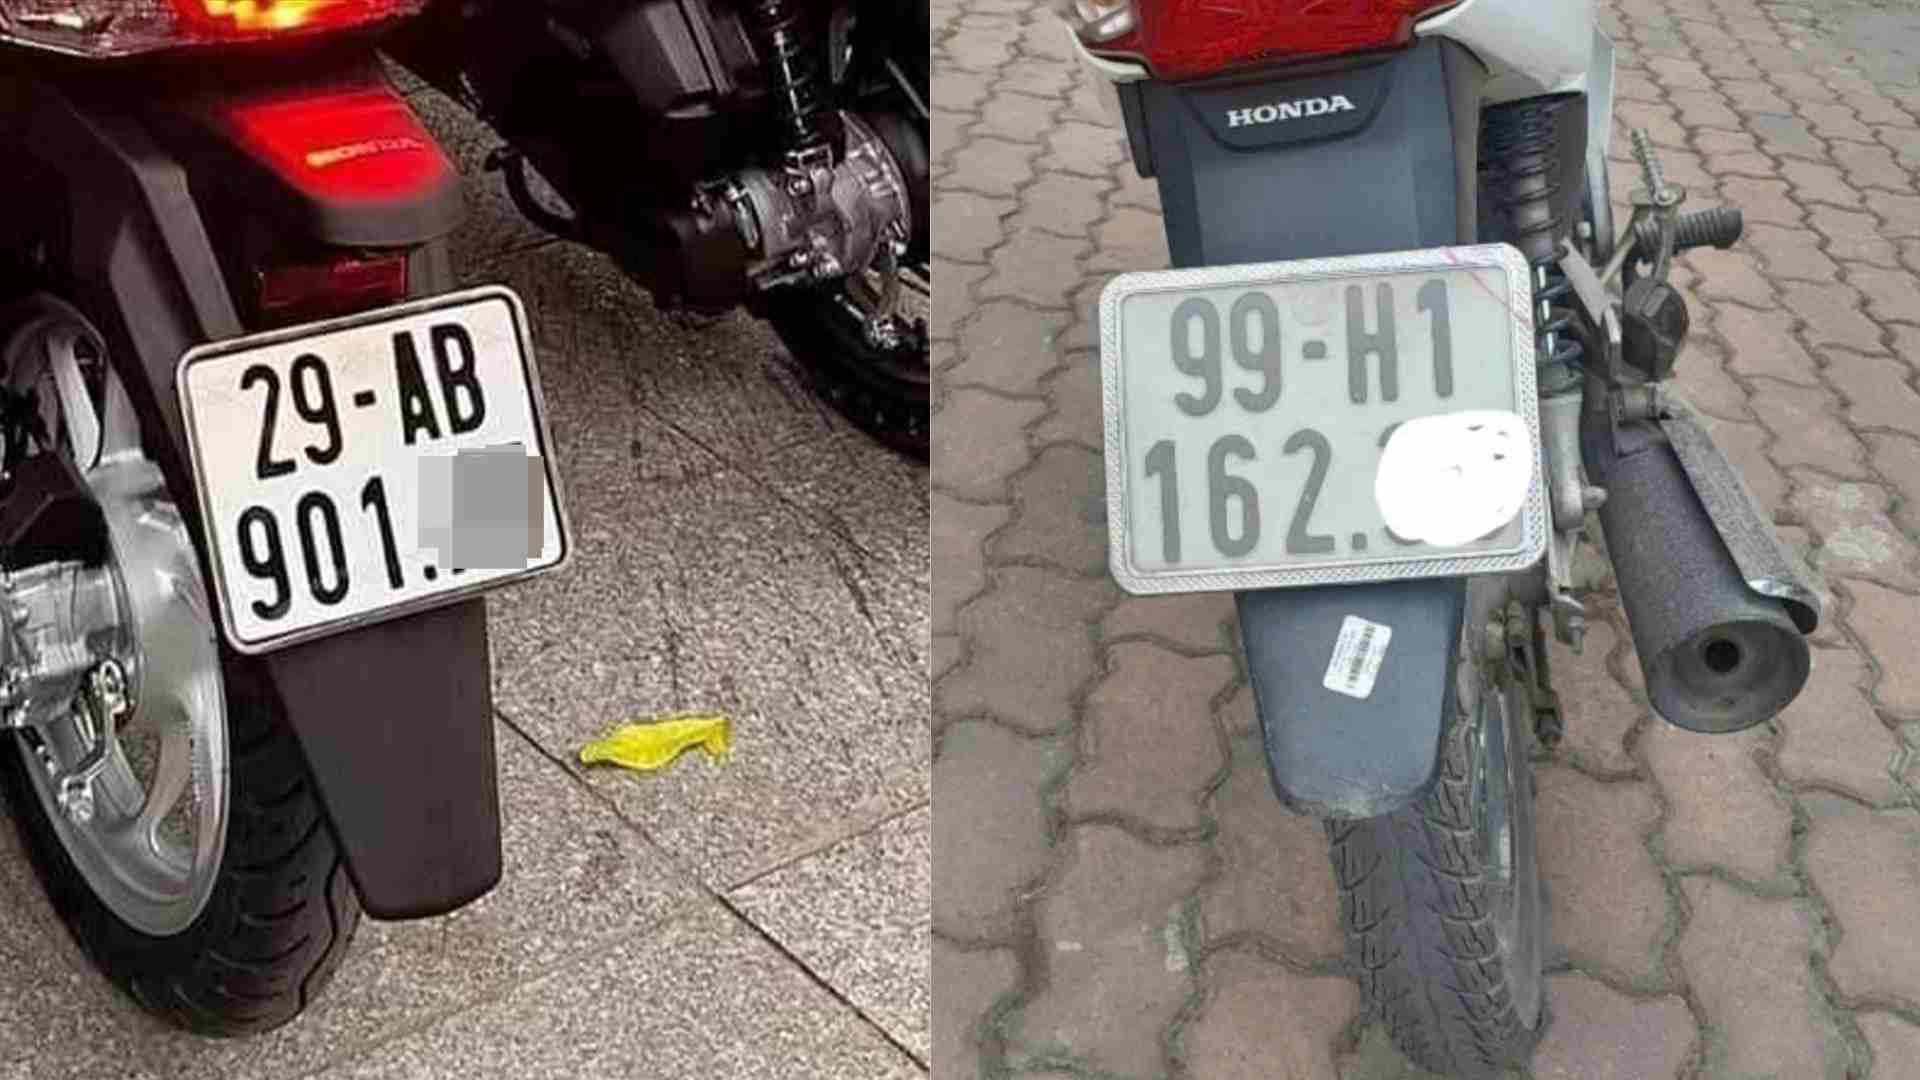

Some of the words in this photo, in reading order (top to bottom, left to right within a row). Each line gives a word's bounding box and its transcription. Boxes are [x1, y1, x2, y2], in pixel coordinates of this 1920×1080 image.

[1226, 95, 1356, 128] HONDA
[241, 322, 486, 480] 29-AB
[1170, 279, 1454, 417] 99-H1
[237, 476, 521, 621] 901.
[1144, 422, 1508, 564] 162.
